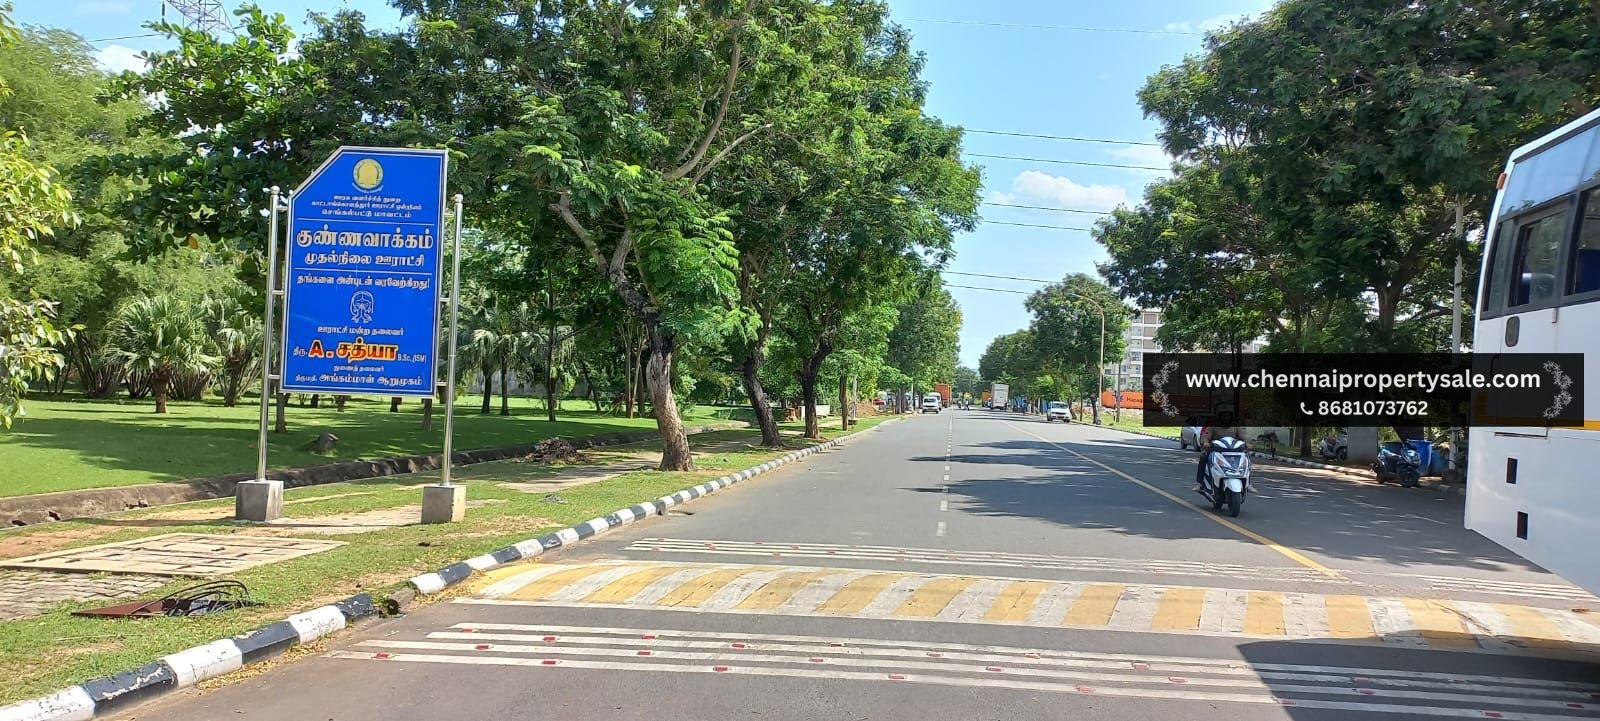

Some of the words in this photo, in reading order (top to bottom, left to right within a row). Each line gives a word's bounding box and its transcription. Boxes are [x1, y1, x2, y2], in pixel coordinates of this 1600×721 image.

[296, 224, 433, 249] குண்ணவாக்கம்
[305, 251, 371, 265] முதல்நிலை
[375, 254, 424, 266] ஊராட்சி
[296, 274, 334, 285] தங்களை
[336, 275, 371, 287] அன்புடன்
[317, 326, 348, 334] ஊராட்சி
[371, 327, 404, 336] தலைவர்
[336, 336, 398, 364] சத்யா
